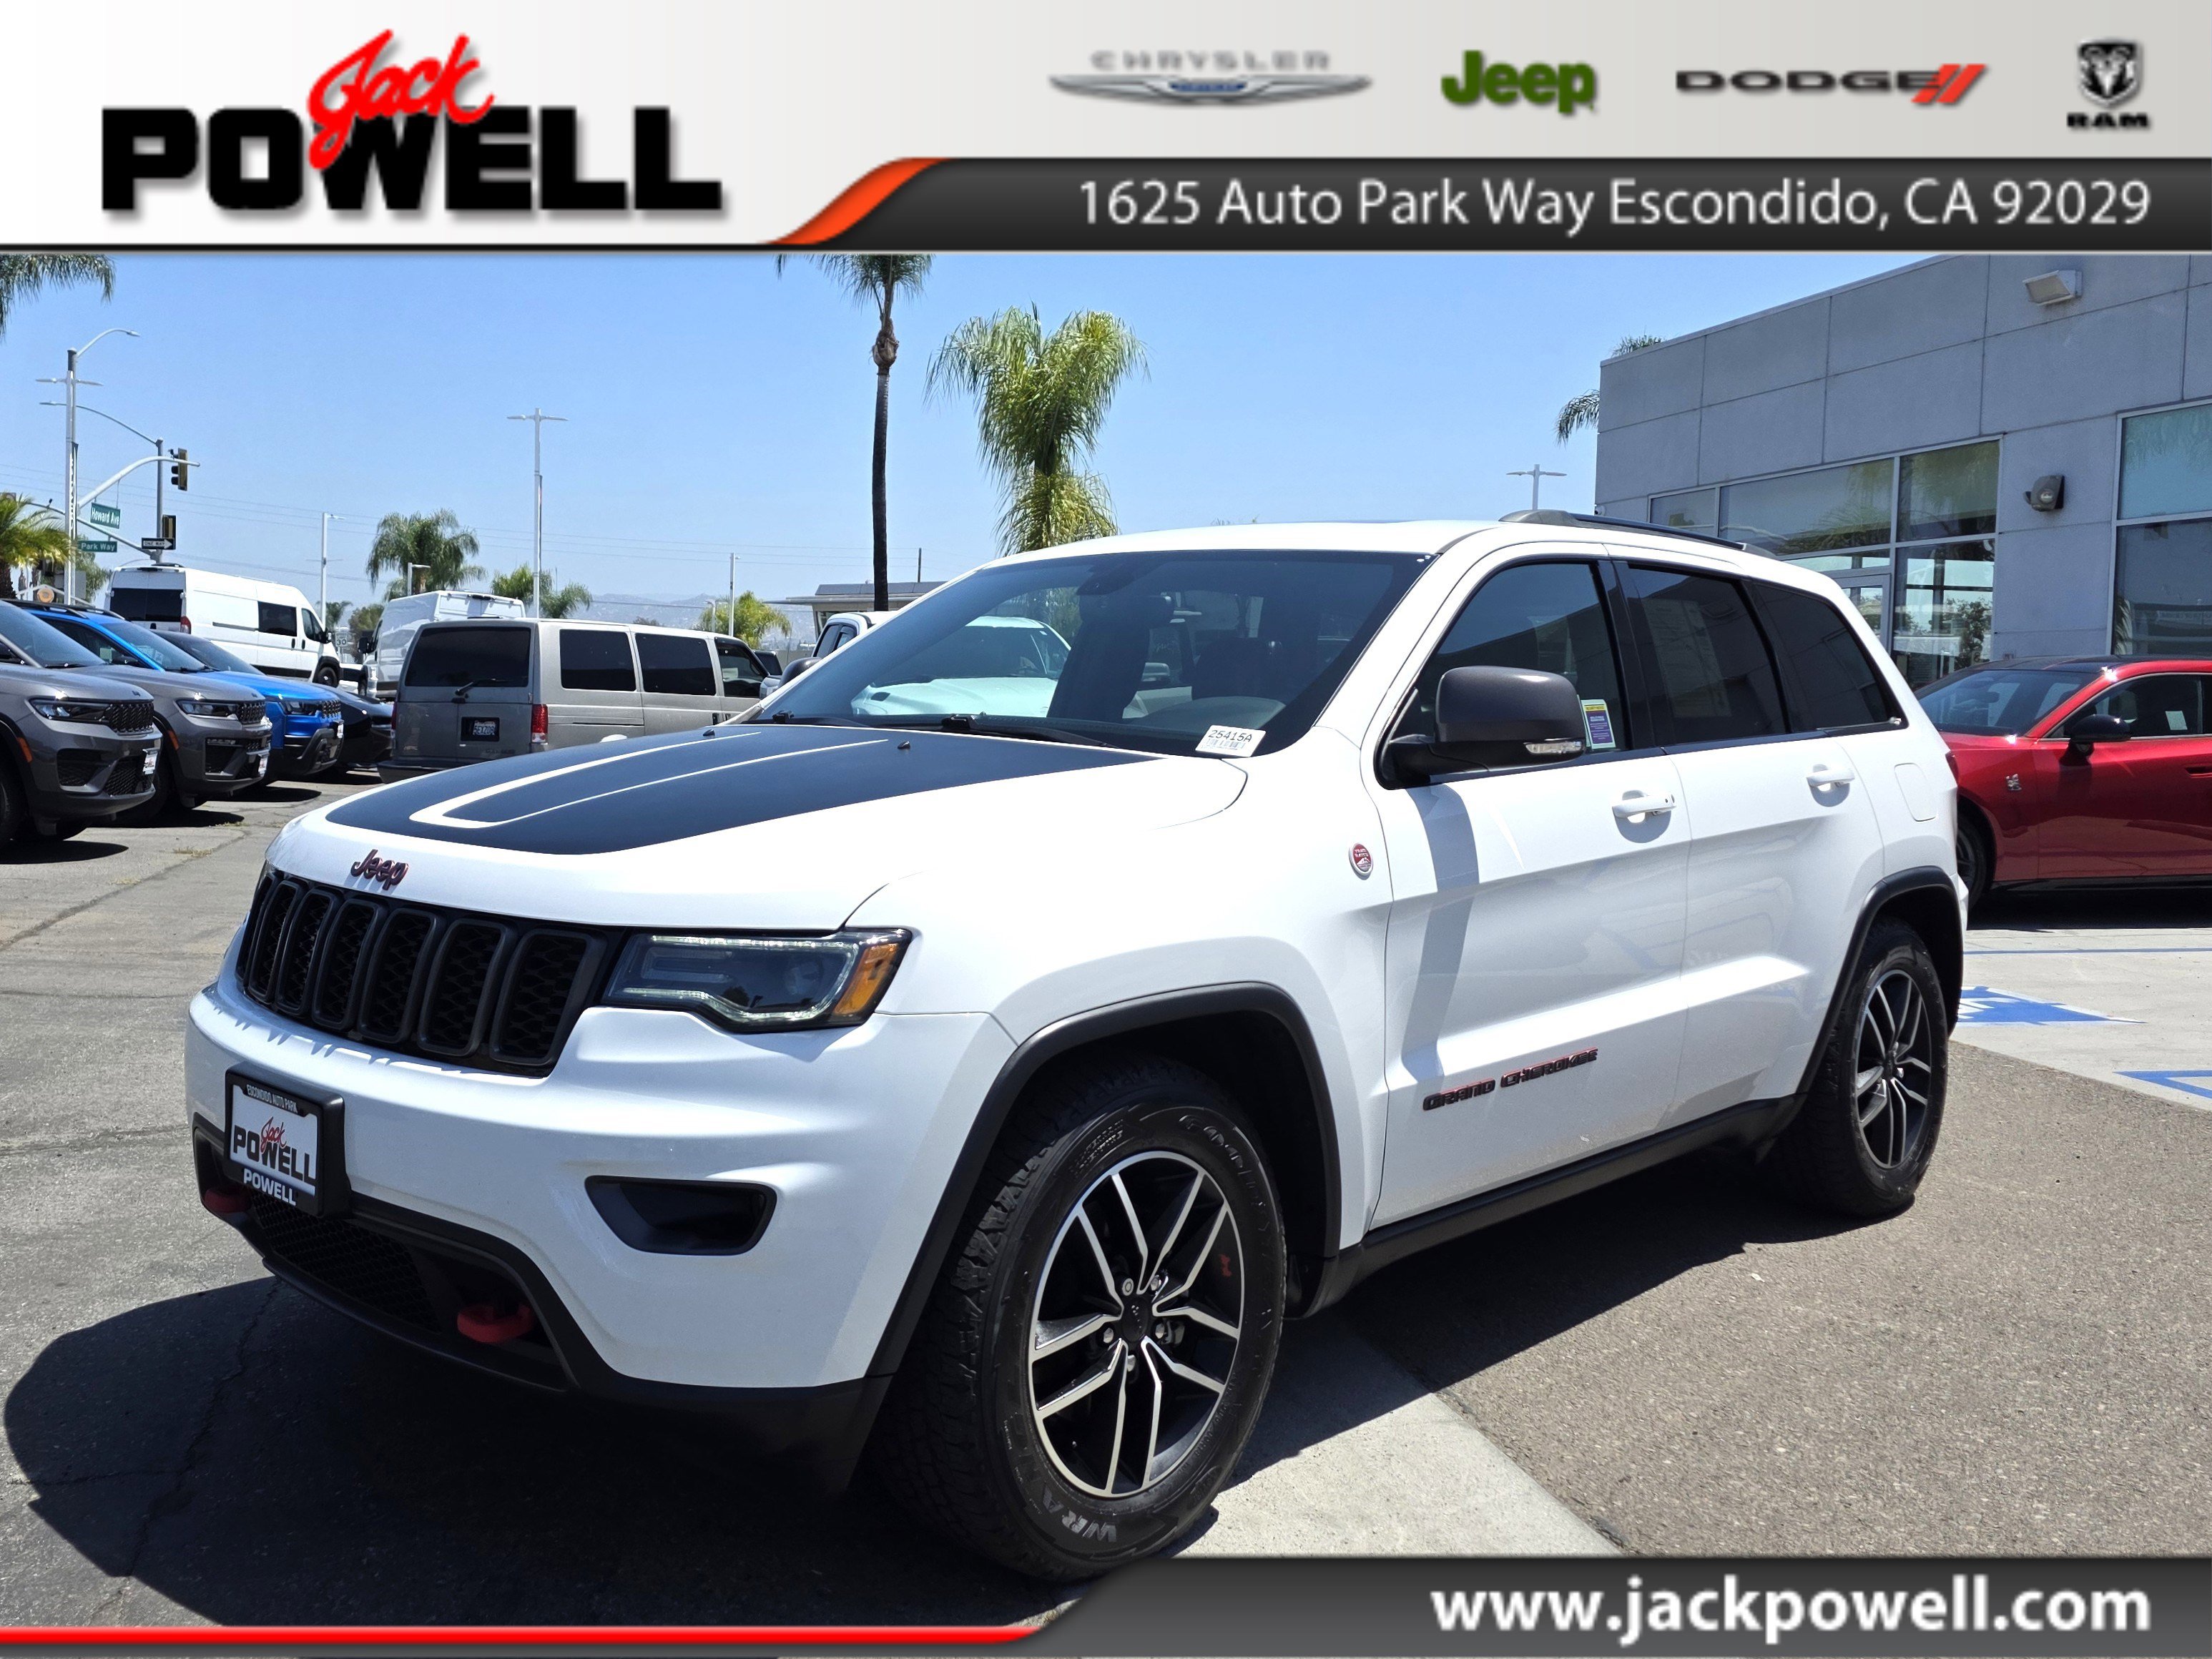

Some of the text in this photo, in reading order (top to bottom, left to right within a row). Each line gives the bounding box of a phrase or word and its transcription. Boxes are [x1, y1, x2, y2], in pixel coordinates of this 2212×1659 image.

[91, 506, 119, 526] Howard Ave
[100, 543, 115, 551] Way
[1208, 729, 1252, 742] 25415A
[350, 849, 410, 891] Jeep
[1422, 1046, 1598, 1111] GRAND CHEROKEE
[233, 1125, 318, 1184] POWELL
[260, 1116, 287, 1155] Jack
[243, 1168, 296, 1206] POWELL
